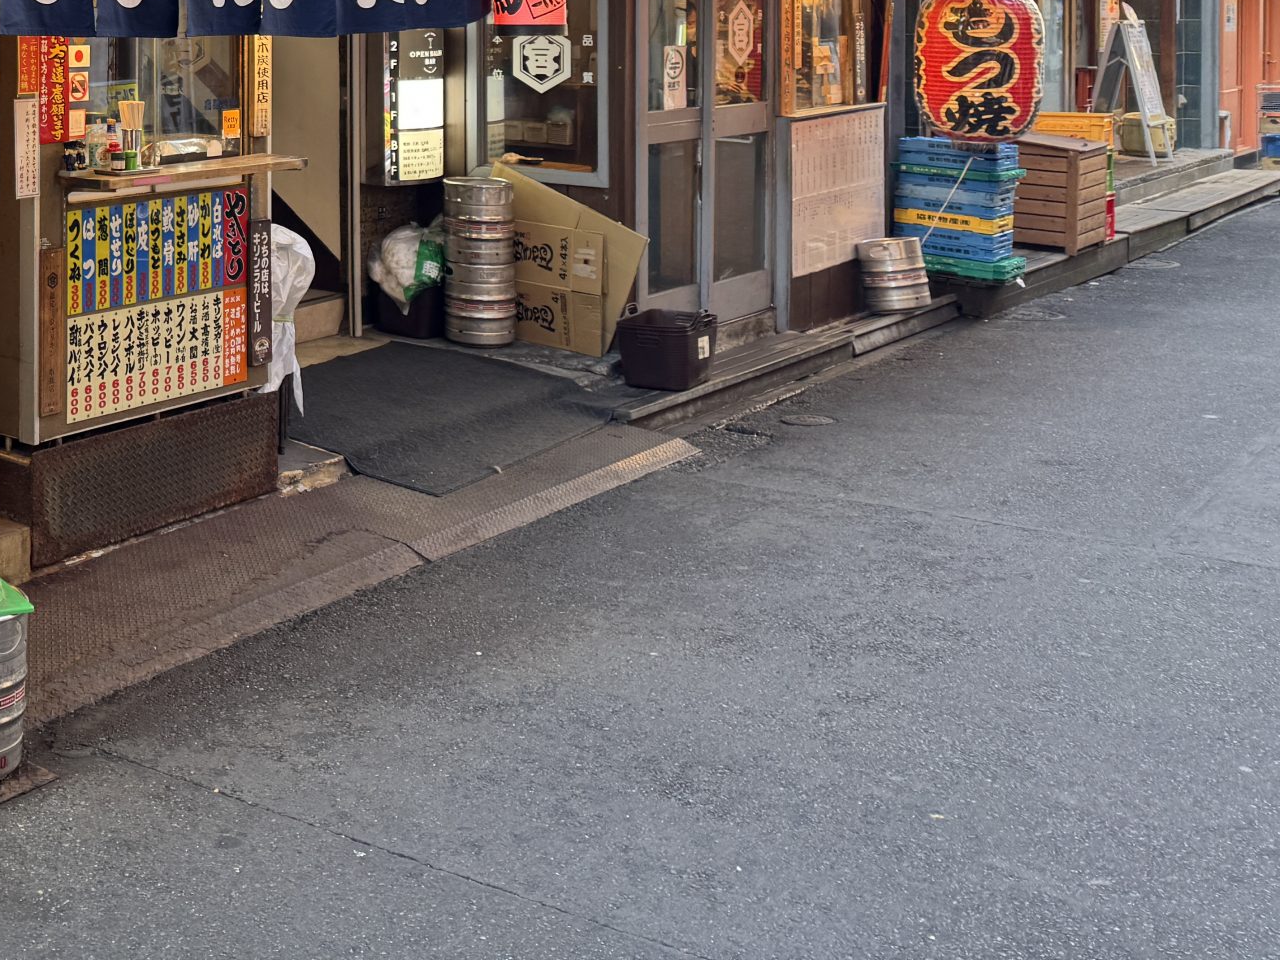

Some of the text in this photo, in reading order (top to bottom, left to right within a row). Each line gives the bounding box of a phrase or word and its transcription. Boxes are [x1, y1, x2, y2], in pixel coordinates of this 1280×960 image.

[257, 36, 269, 103] 木炭使用店
[68, 219, 81, 283] つくね
[83, 218, 95, 279] はつ
[111, 214, 122, 276] せせり
[200, 200, 210, 260] かしわ
[225, 191, 248, 281] やきとり
[253, 233, 262, 333] キリンラガービール
[261, 232, 269, 299] うちの店は、
[83, 321, 94, 382] バイスハイ
[97, 320, 108, 380] ウーロンハイ
[110, 318, 120, 377] レモンハイ
[123, 315, 136, 375] ハイボール
[164, 307, 173, 364] ホッピー
